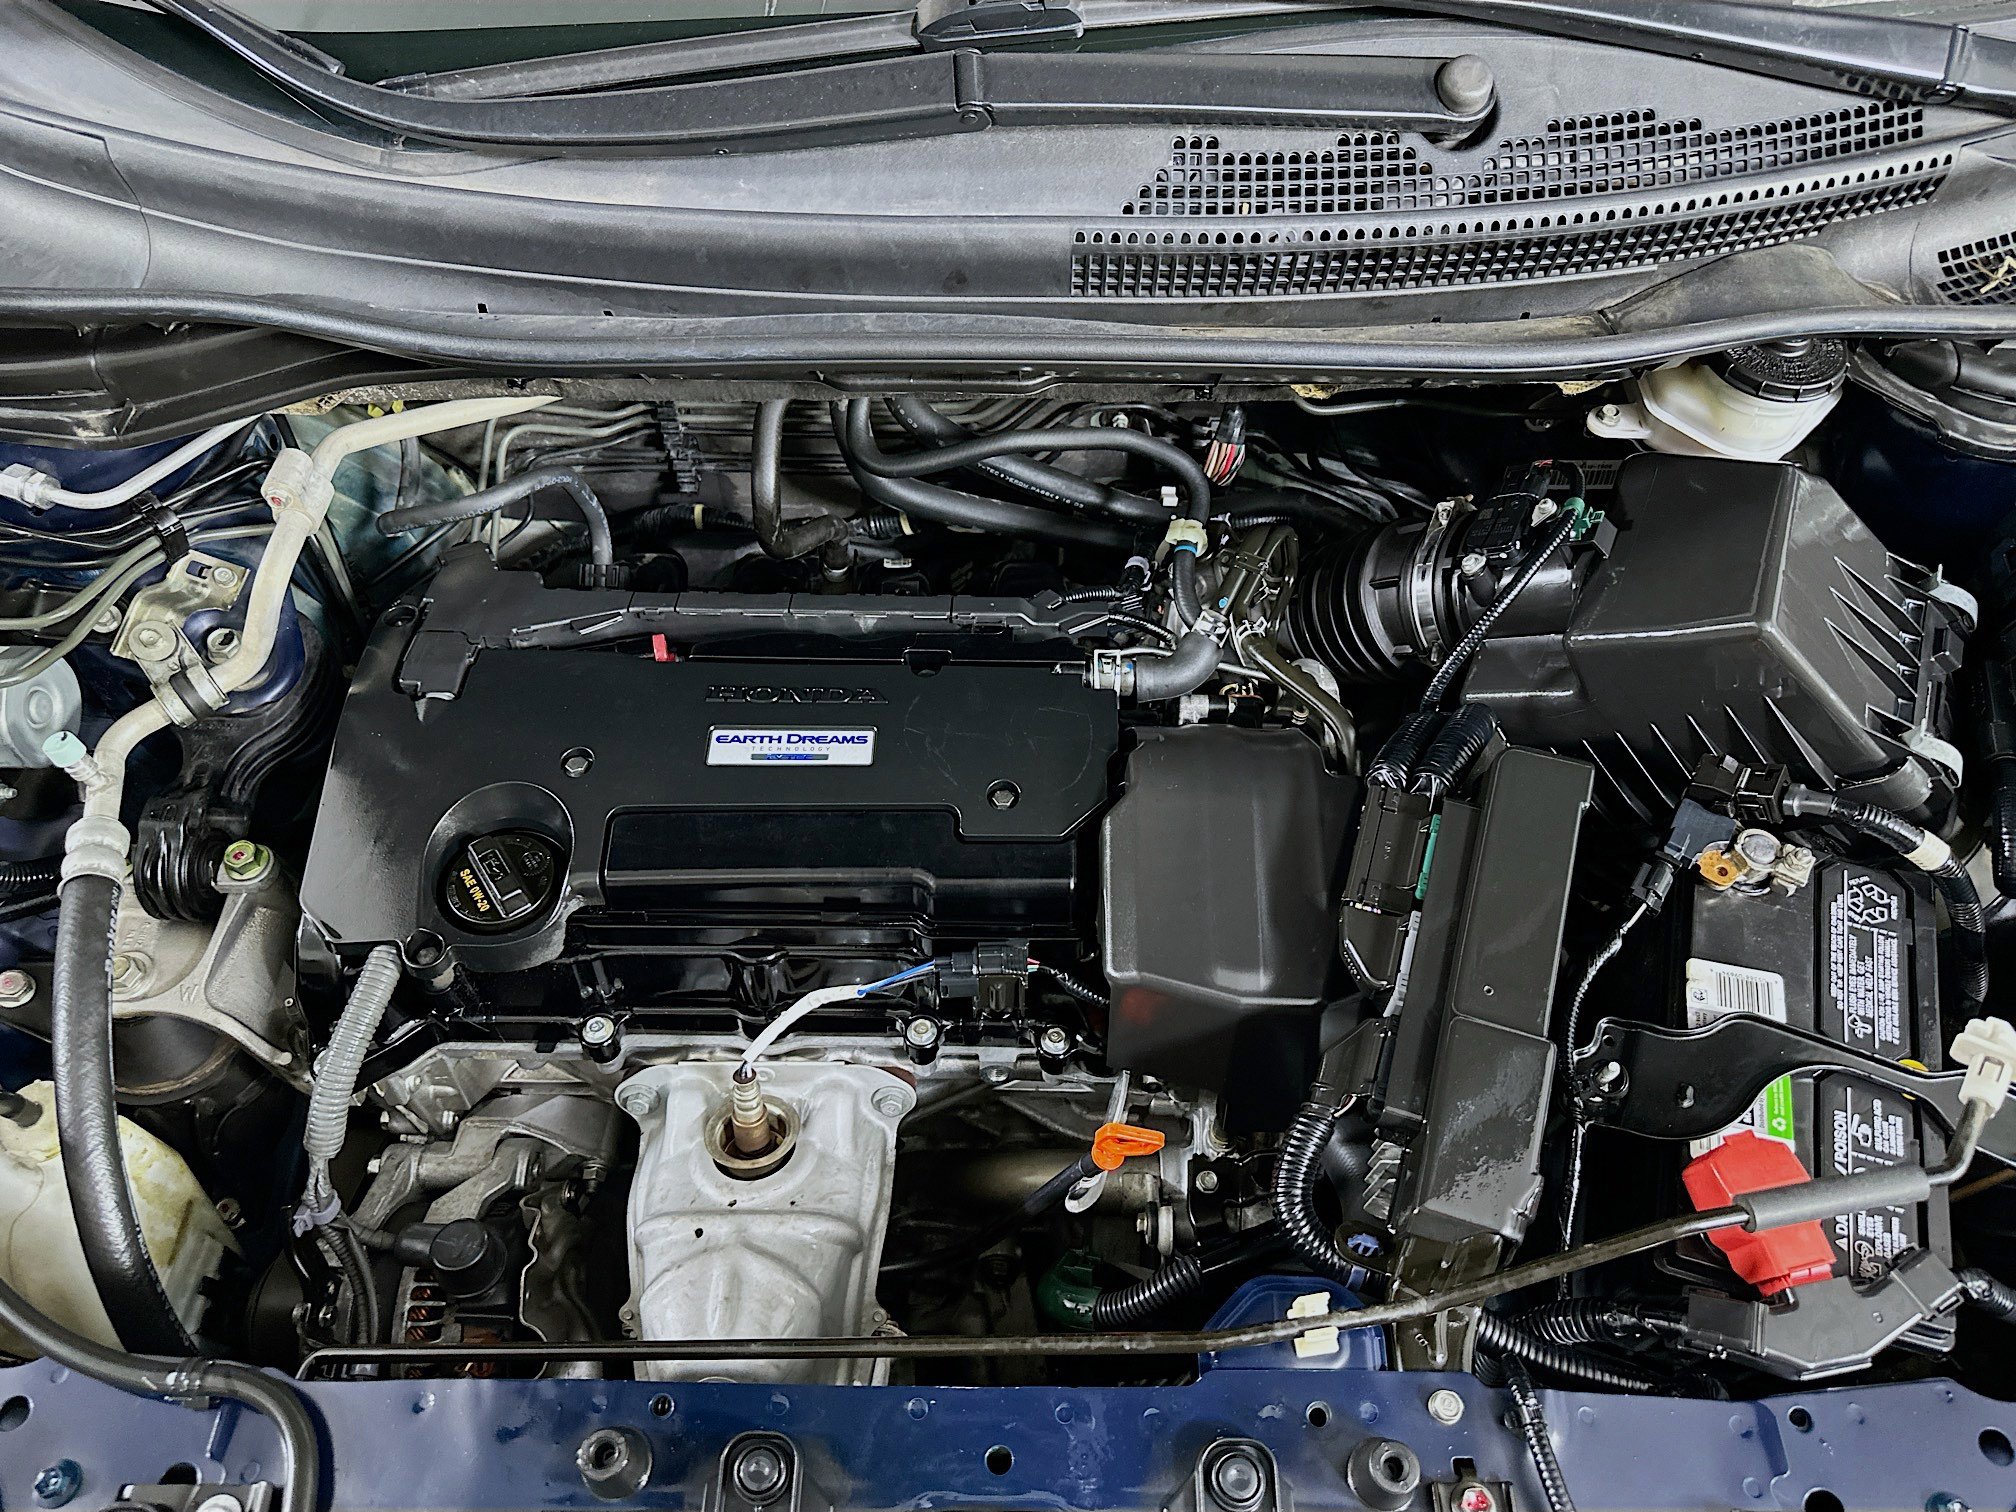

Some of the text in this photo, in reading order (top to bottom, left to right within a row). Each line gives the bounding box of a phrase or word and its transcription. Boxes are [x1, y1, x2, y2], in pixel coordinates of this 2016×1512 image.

[705, 685, 889, 704] HONDA
[716, 734, 868, 744] EARTH DREAMS
[460, 868, 490, 912] SAE 0W-20
